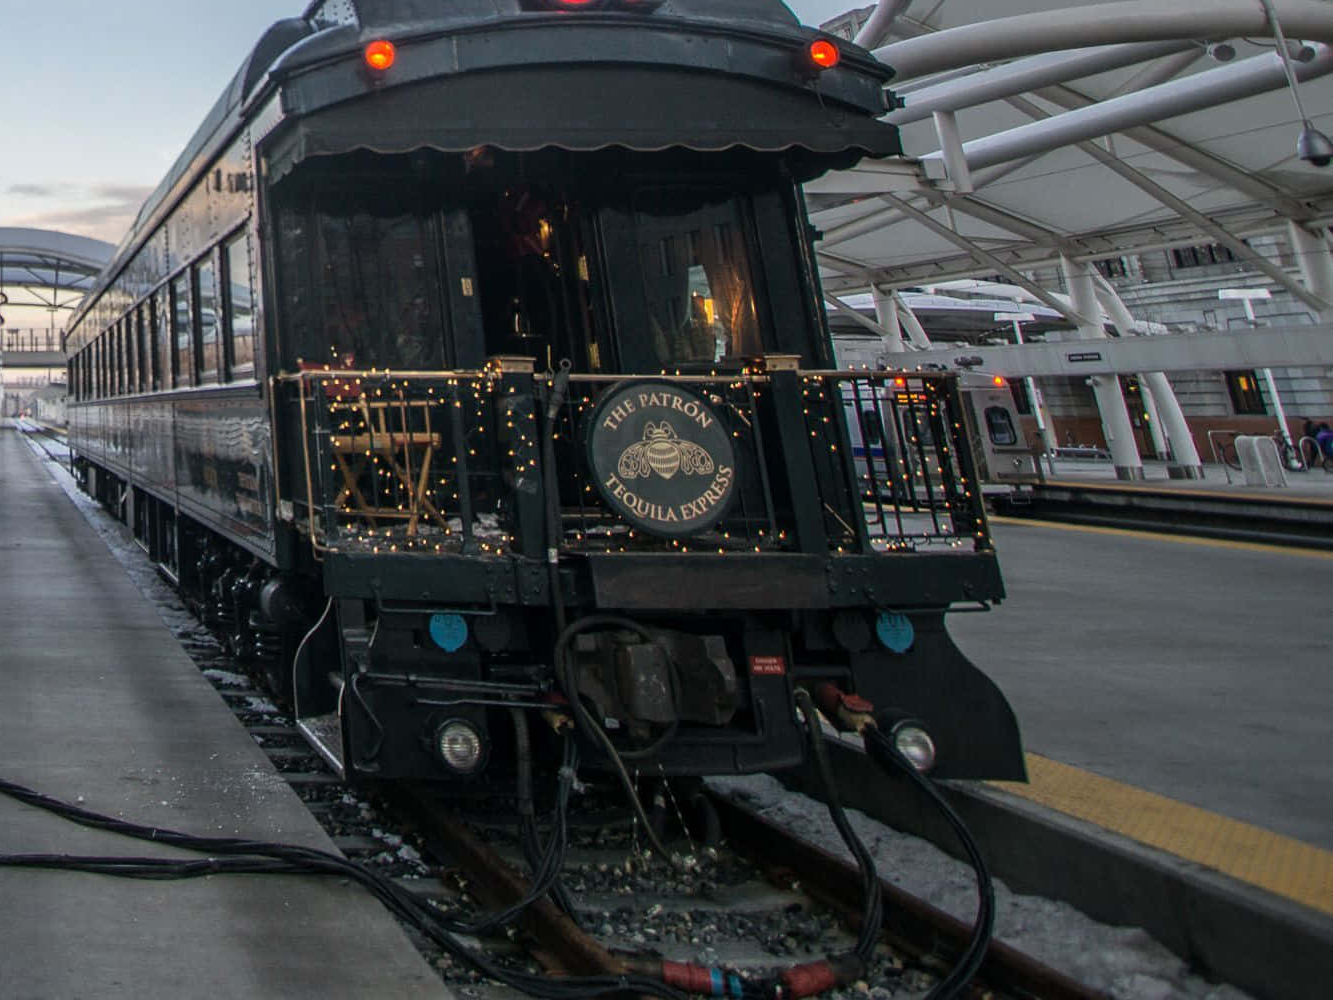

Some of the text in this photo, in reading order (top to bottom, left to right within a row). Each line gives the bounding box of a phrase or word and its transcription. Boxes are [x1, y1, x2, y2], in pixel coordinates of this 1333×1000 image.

[603, 392, 714, 431] THE PATRÓN
[604, 464, 732, 522] TEQUILA EXPRESS
